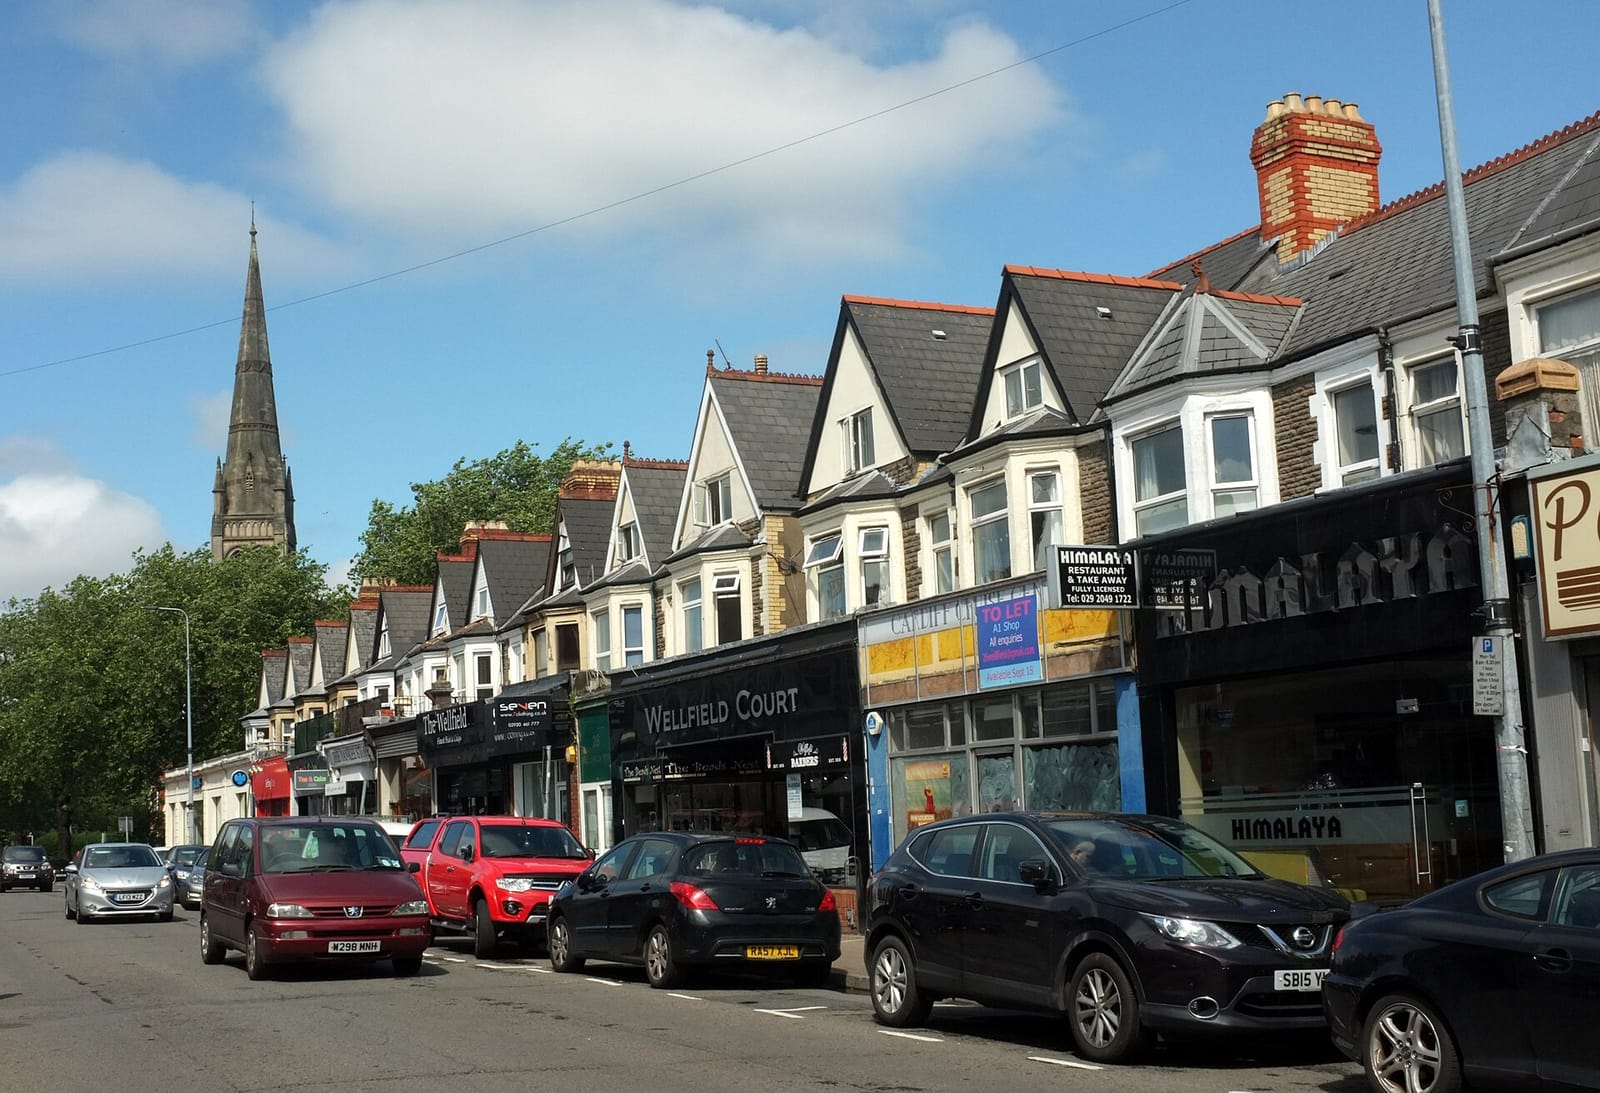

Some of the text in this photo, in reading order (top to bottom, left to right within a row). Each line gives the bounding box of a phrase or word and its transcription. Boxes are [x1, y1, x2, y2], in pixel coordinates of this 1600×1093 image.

[1544, 479, 1600, 562] P
[1060, 550, 1132, 565] HIMALAYA
[1068, 566, 1125, 575] RESTAURANT
[1067, 576, 1074, 584] &
[1076, 576, 1099, 584] TAKE
[1066, 594, 1132, 603] Tel: 029 2049 1722
[891, 604, 950, 635] CARDIFF
[982, 600, 1032, 624] TO LET
[993, 620, 1020, 633] A1 Shop
[997, 633, 1023, 646] enquiries
[644, 688, 798, 734] WELLFIELD COURT
[423, 714, 436, 735] The
[436, 706, 467, 732] Wellfield
[665, 762, 689, 774] The
[1232, 816, 1343, 840] HIMALAYA
[751, 946, 794, 956] RA57 XJL
[1283, 972, 1311, 987] SB15
